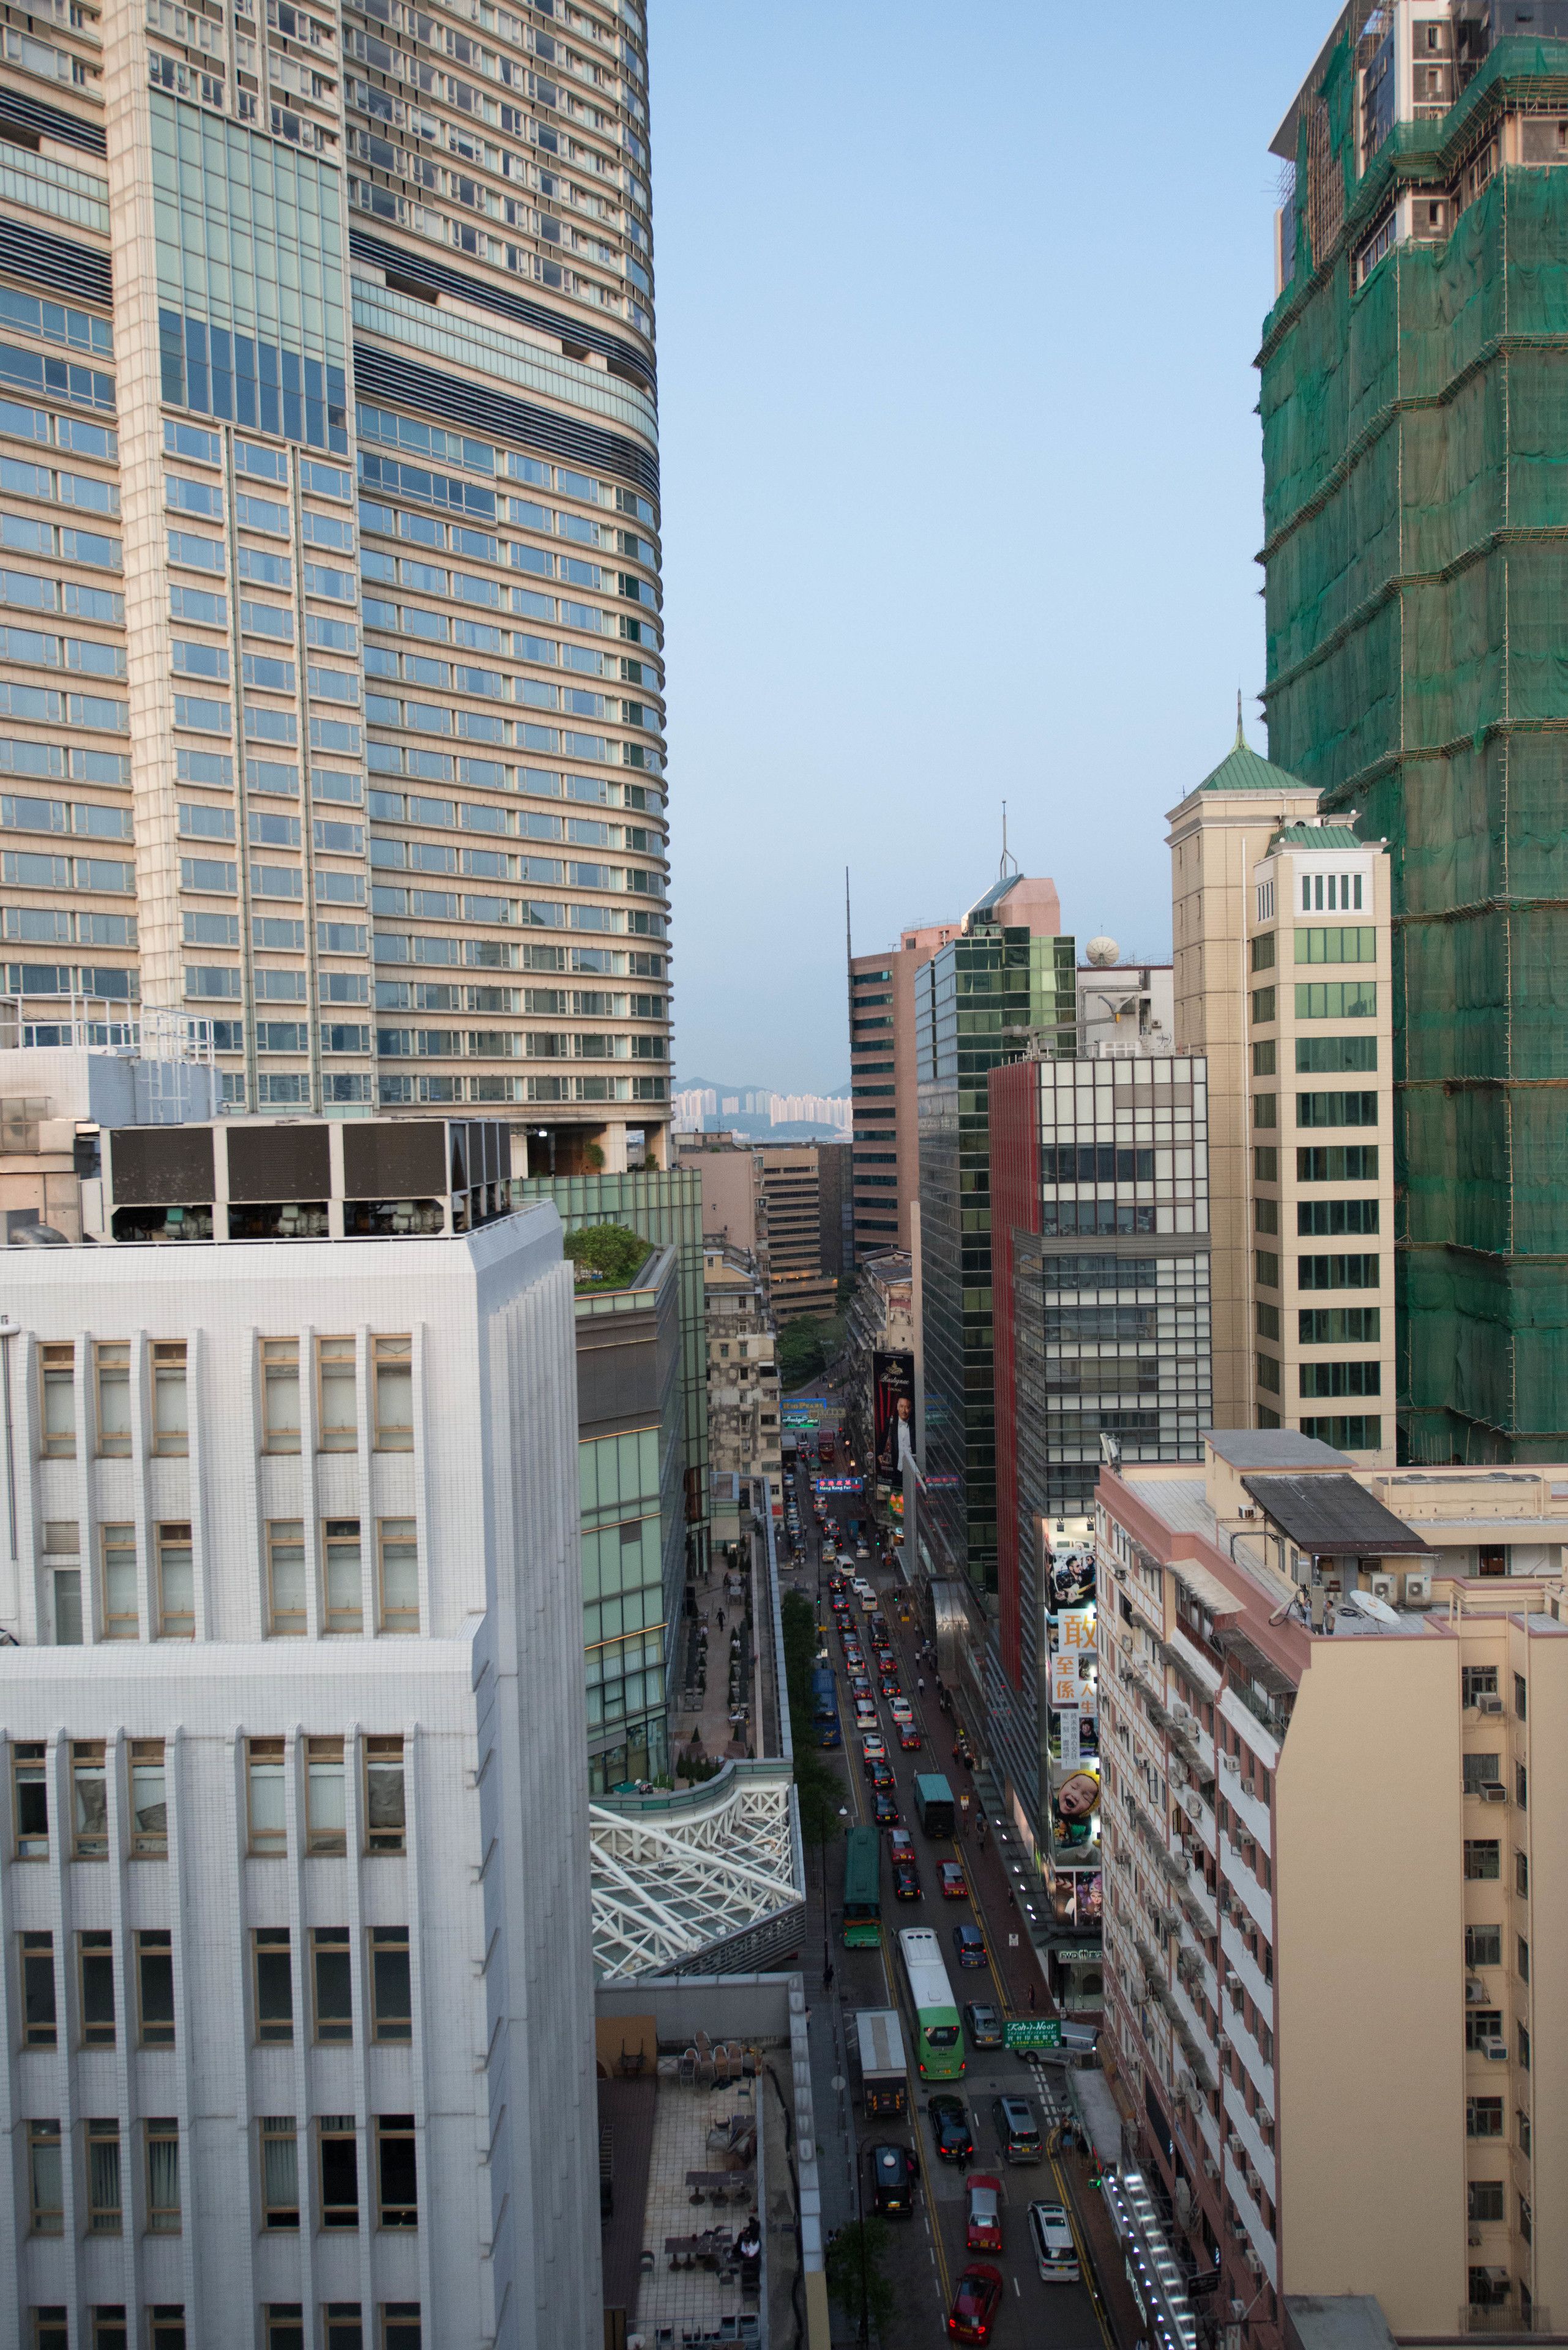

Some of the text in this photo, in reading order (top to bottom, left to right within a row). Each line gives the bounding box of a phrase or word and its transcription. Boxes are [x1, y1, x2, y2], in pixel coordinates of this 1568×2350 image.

[881, 1373, 910, 1387] Rastignac
[1064, 1615, 1097, 1649] 敢
[1056, 1656, 1075, 1699] 至係
[1081, 1684, 1094, 1714] 人生
